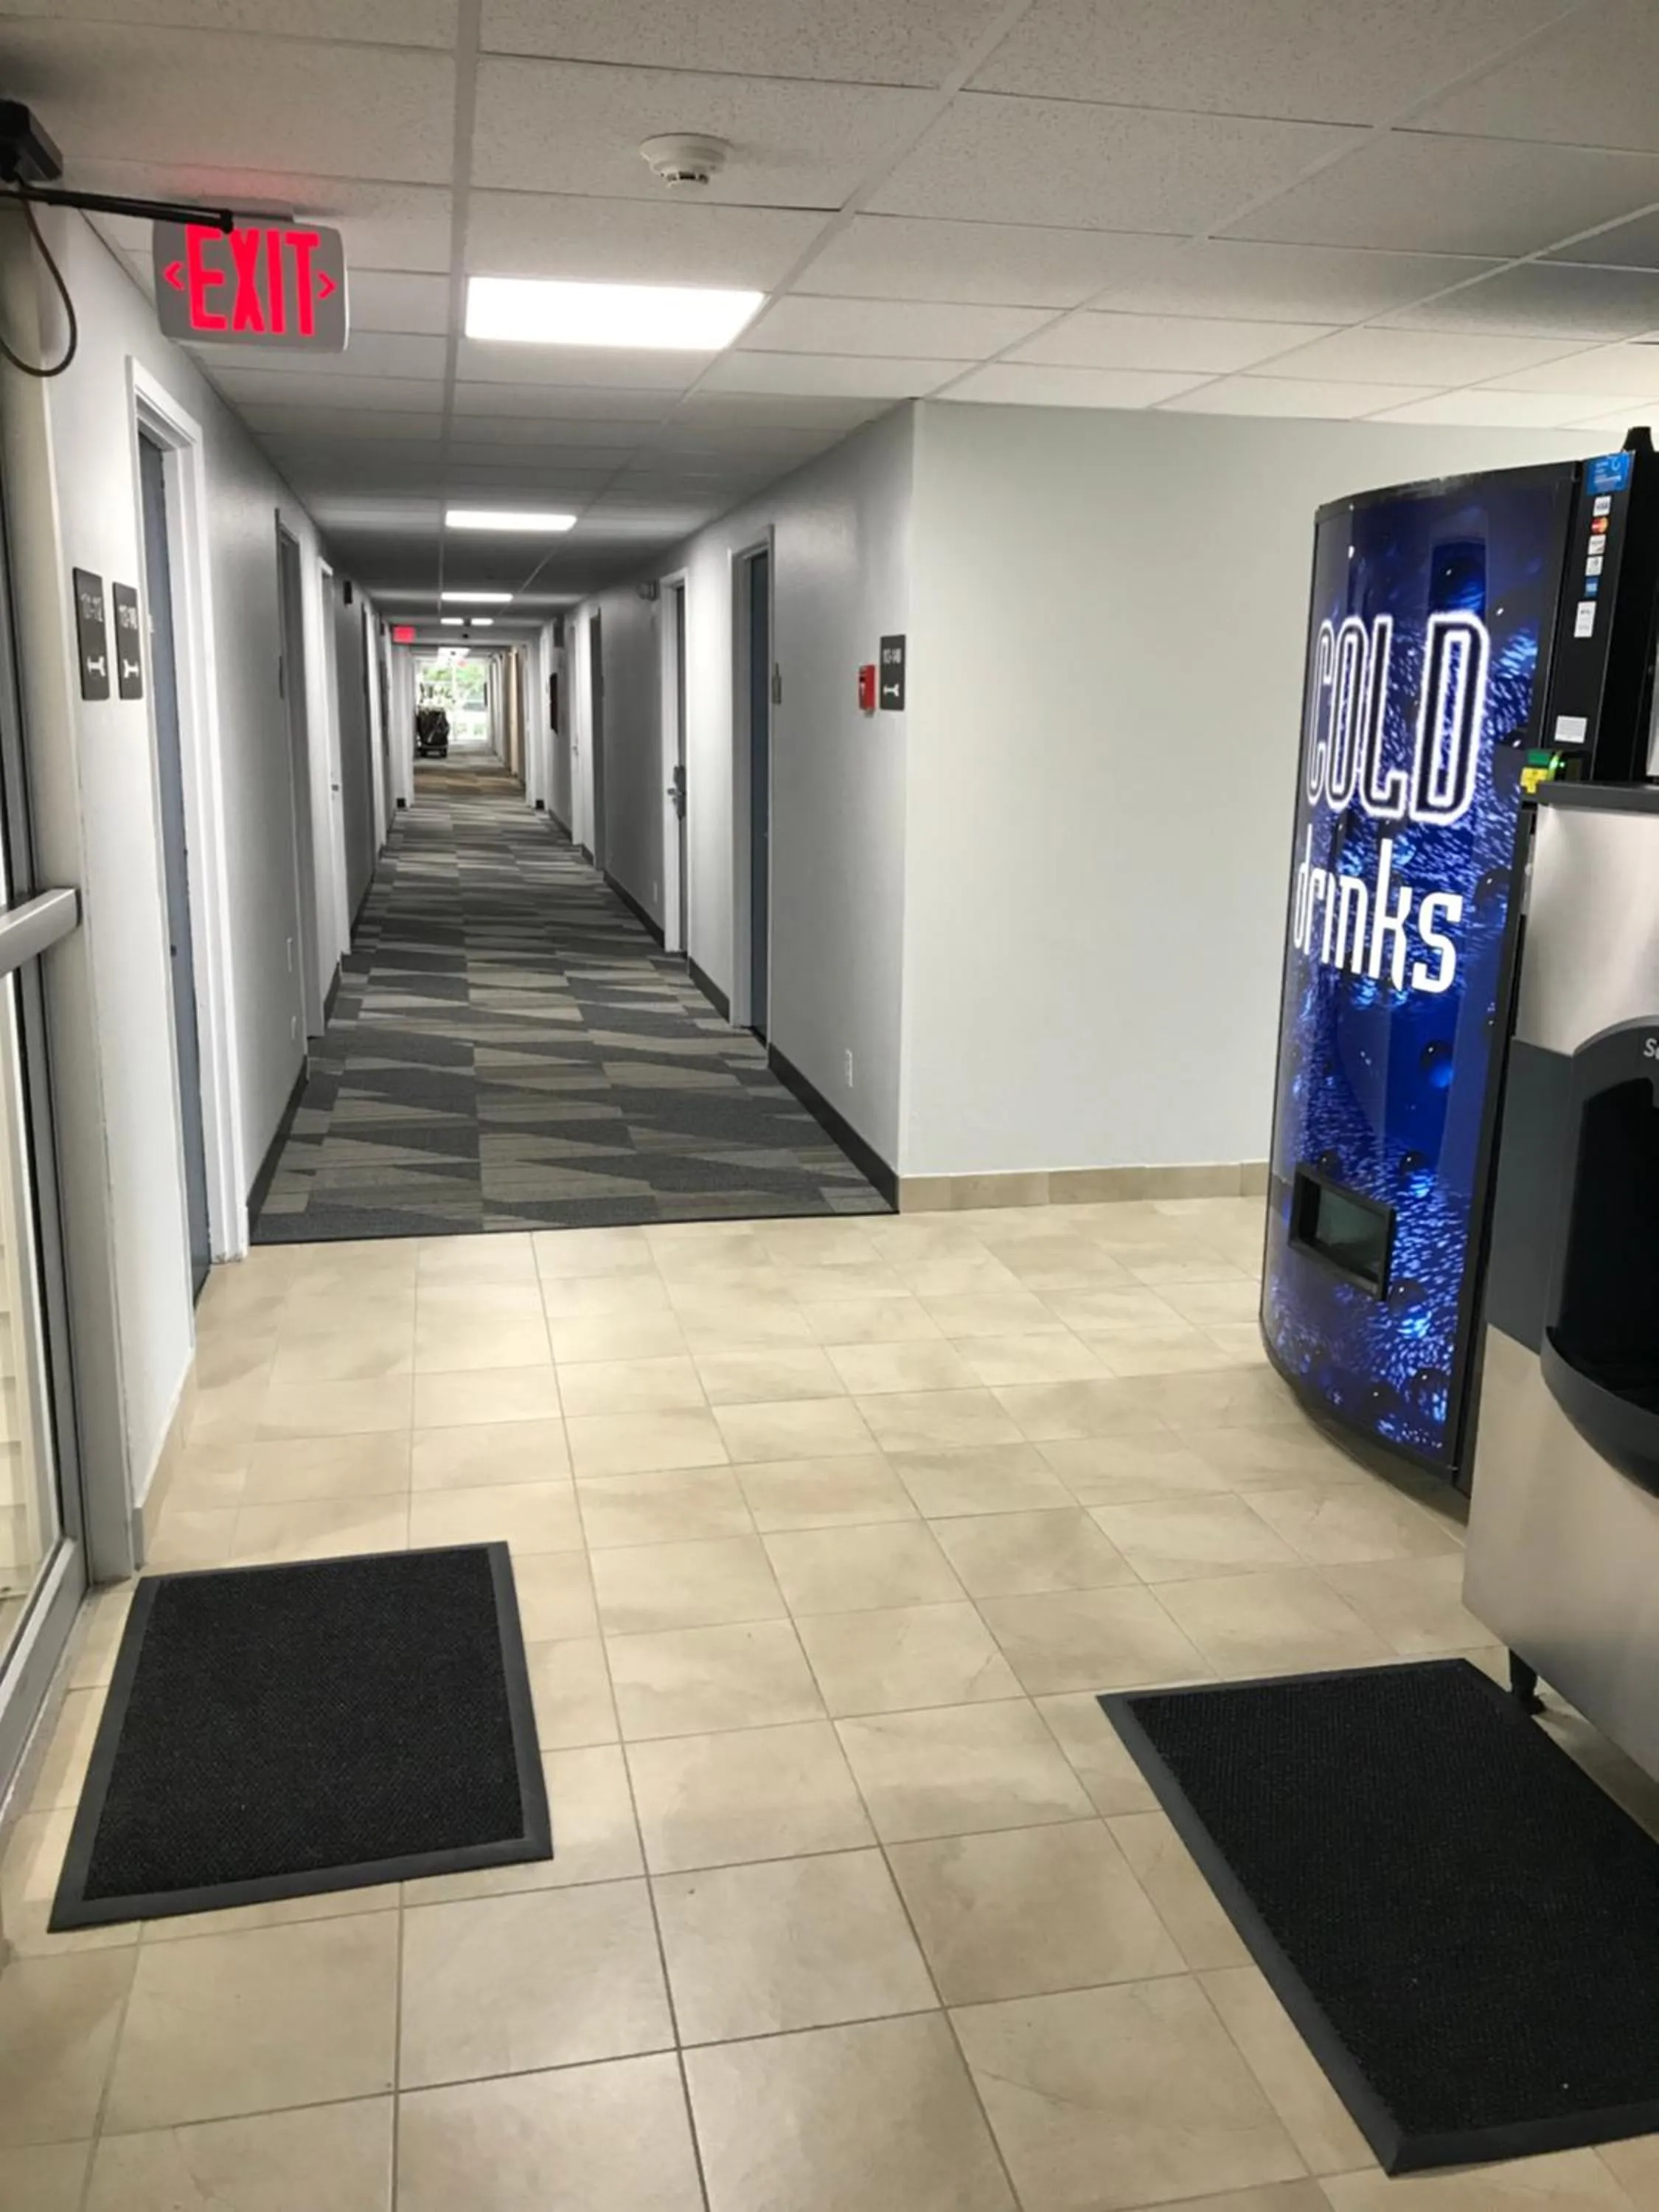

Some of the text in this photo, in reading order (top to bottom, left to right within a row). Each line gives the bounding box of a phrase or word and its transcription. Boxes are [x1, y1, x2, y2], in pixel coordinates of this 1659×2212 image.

[186, 223, 321, 337] EXIT
[1307, 610, 1489, 825] COLD
[1293, 823, 1464, 994] drinks
